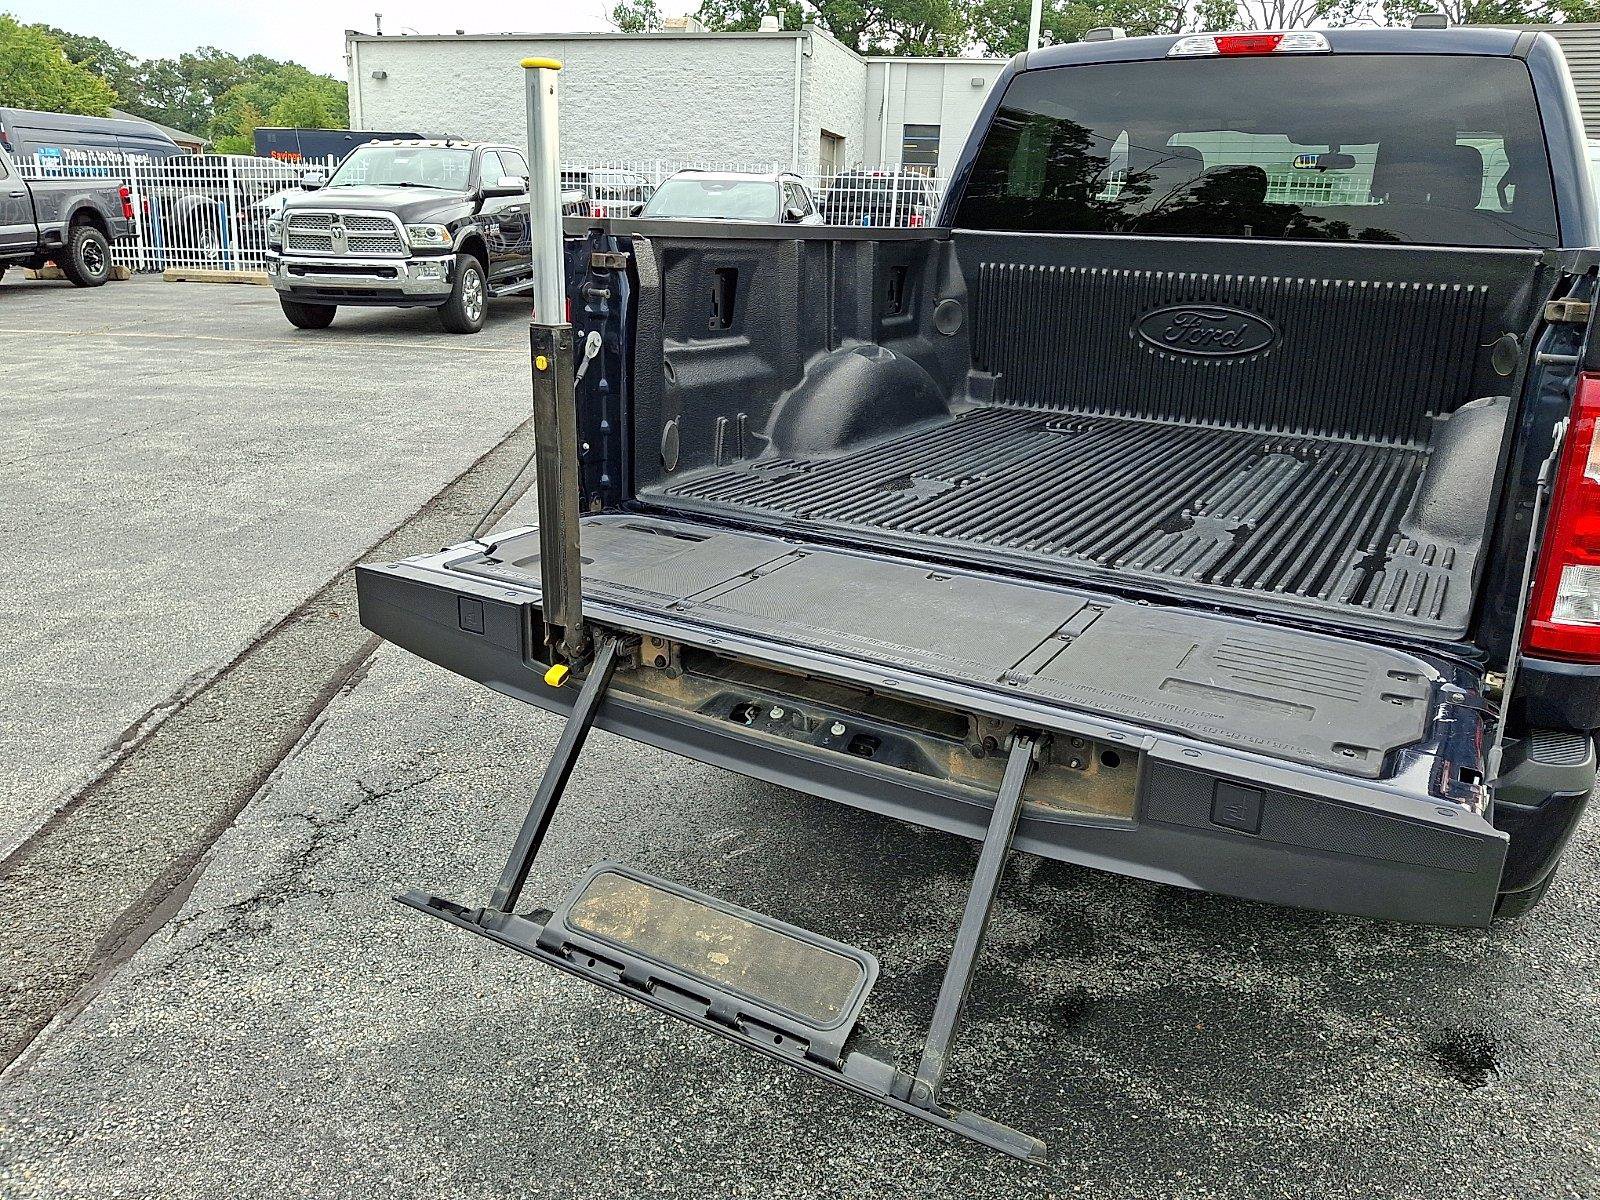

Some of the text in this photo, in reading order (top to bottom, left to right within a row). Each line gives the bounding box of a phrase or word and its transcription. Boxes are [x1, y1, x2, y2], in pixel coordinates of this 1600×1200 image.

[63, 148, 150, 164] Take it to the house!
[1164, 311, 1248, 348] Ford
